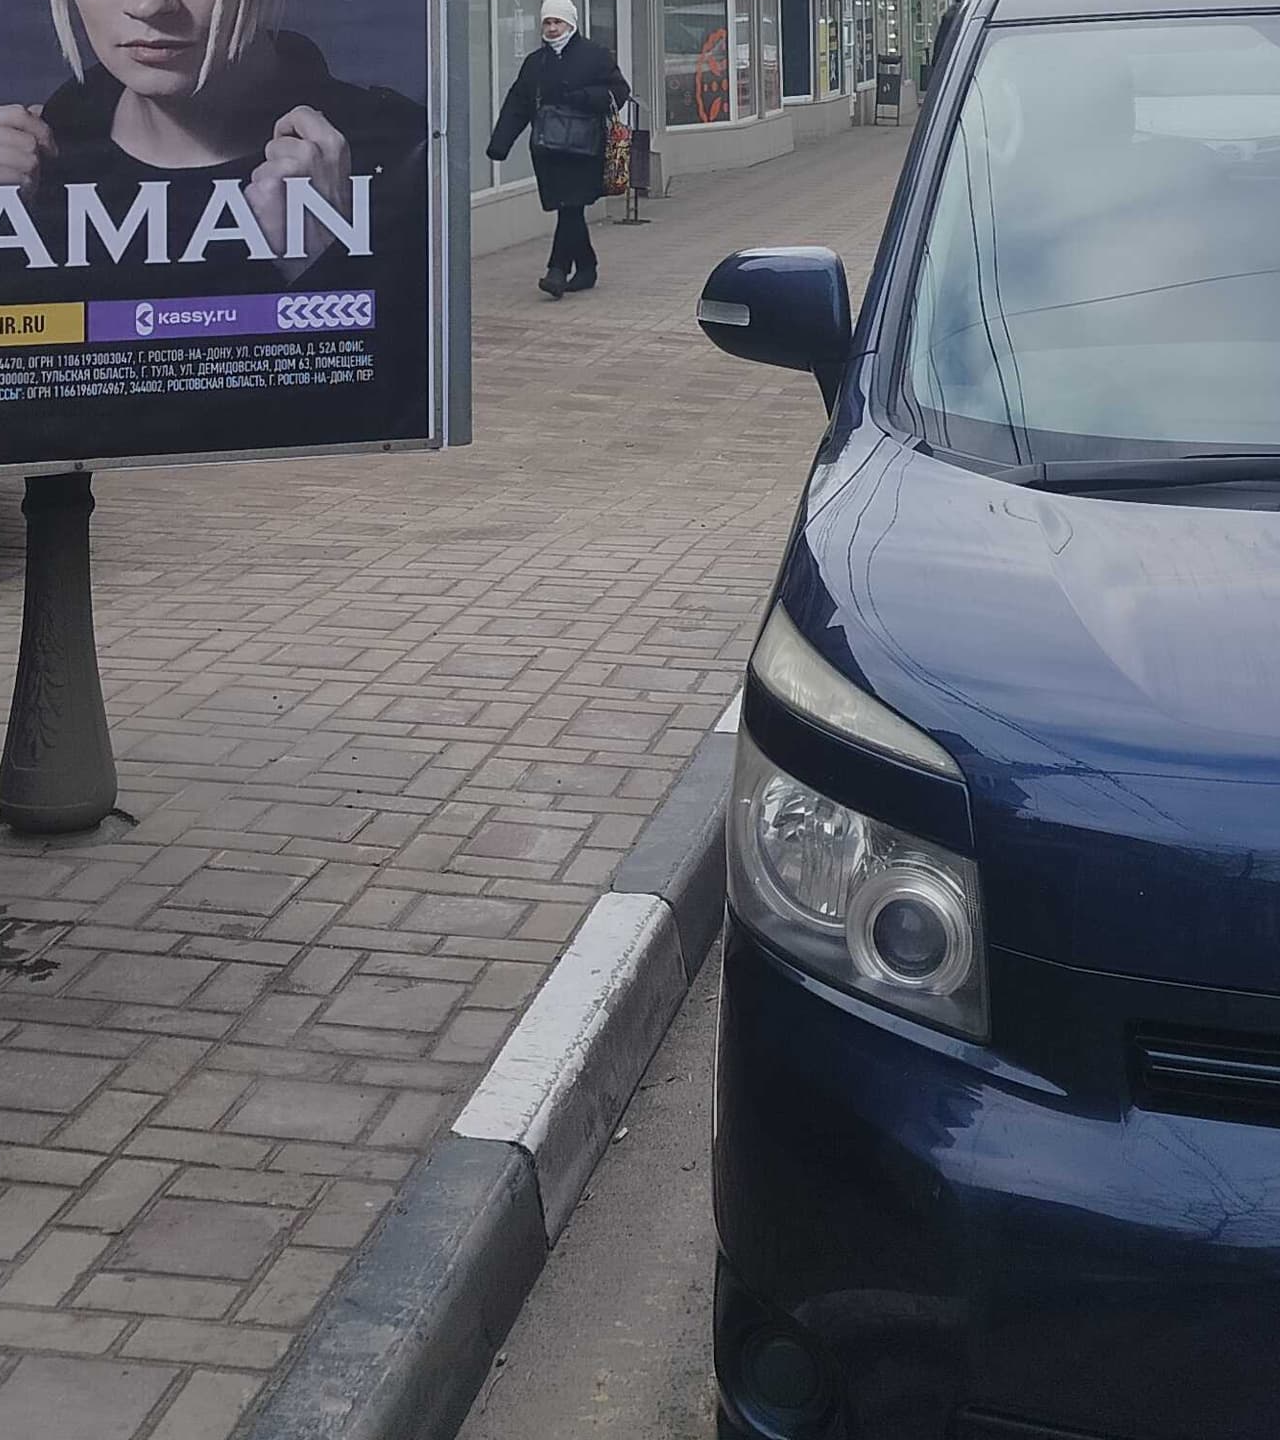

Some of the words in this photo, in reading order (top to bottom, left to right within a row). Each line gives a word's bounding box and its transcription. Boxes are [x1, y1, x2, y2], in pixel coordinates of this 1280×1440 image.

[158, 309, 237, 327] kassy.ru
[28, 356, 54, 369] ОГРН
[236, 346, 251, 358] УЛ.
[253, 343, 304, 357] СУВОРОВА,
[319, 341, 336, 354] 52А
[339, 340, 364, 353] ОФИС
[41, 369, 90, 383] ТУЛЬСКАЯ
[93, 367, 139, 381] ОБЛАСТЬ,
[197, 360, 271, 376] ДЕМИДОВСКАЯ,
[273, 359, 296, 372] ДОМ
[315, 354, 374, 369] ПОМЕЩЕНИЕ
[27, 386, 51, 399] ОГРН
[168, 377, 224, 392] РОСТОВСКАЯ
